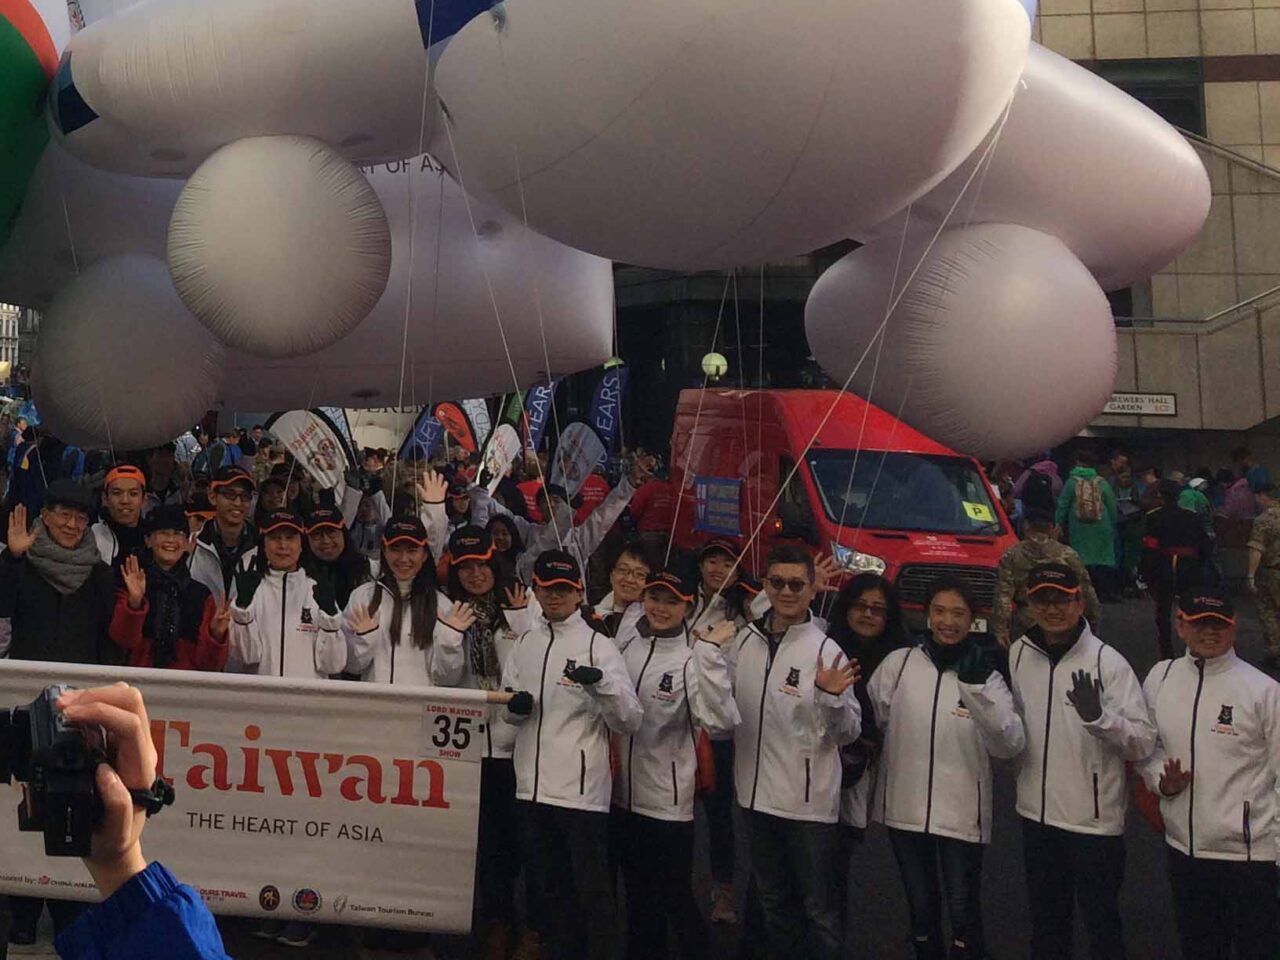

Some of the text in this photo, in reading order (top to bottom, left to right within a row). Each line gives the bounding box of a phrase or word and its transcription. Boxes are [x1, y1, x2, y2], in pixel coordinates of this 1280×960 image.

[1109, 403, 1142, 411] GARDEN
[973, 507, 983, 516] P
[427, 704, 482, 717] LORD MAYOR'S
[432, 714, 472, 750] 35
[439, 749, 461, 758] SHOW
[150, 719, 450, 809] Taiwan
[186, 811, 385, 843] THE HEART OF ASIA
[221, 890, 248, 898] TRAVEL
[350, 904, 434, 917] Taiwan Tourism Bureau
